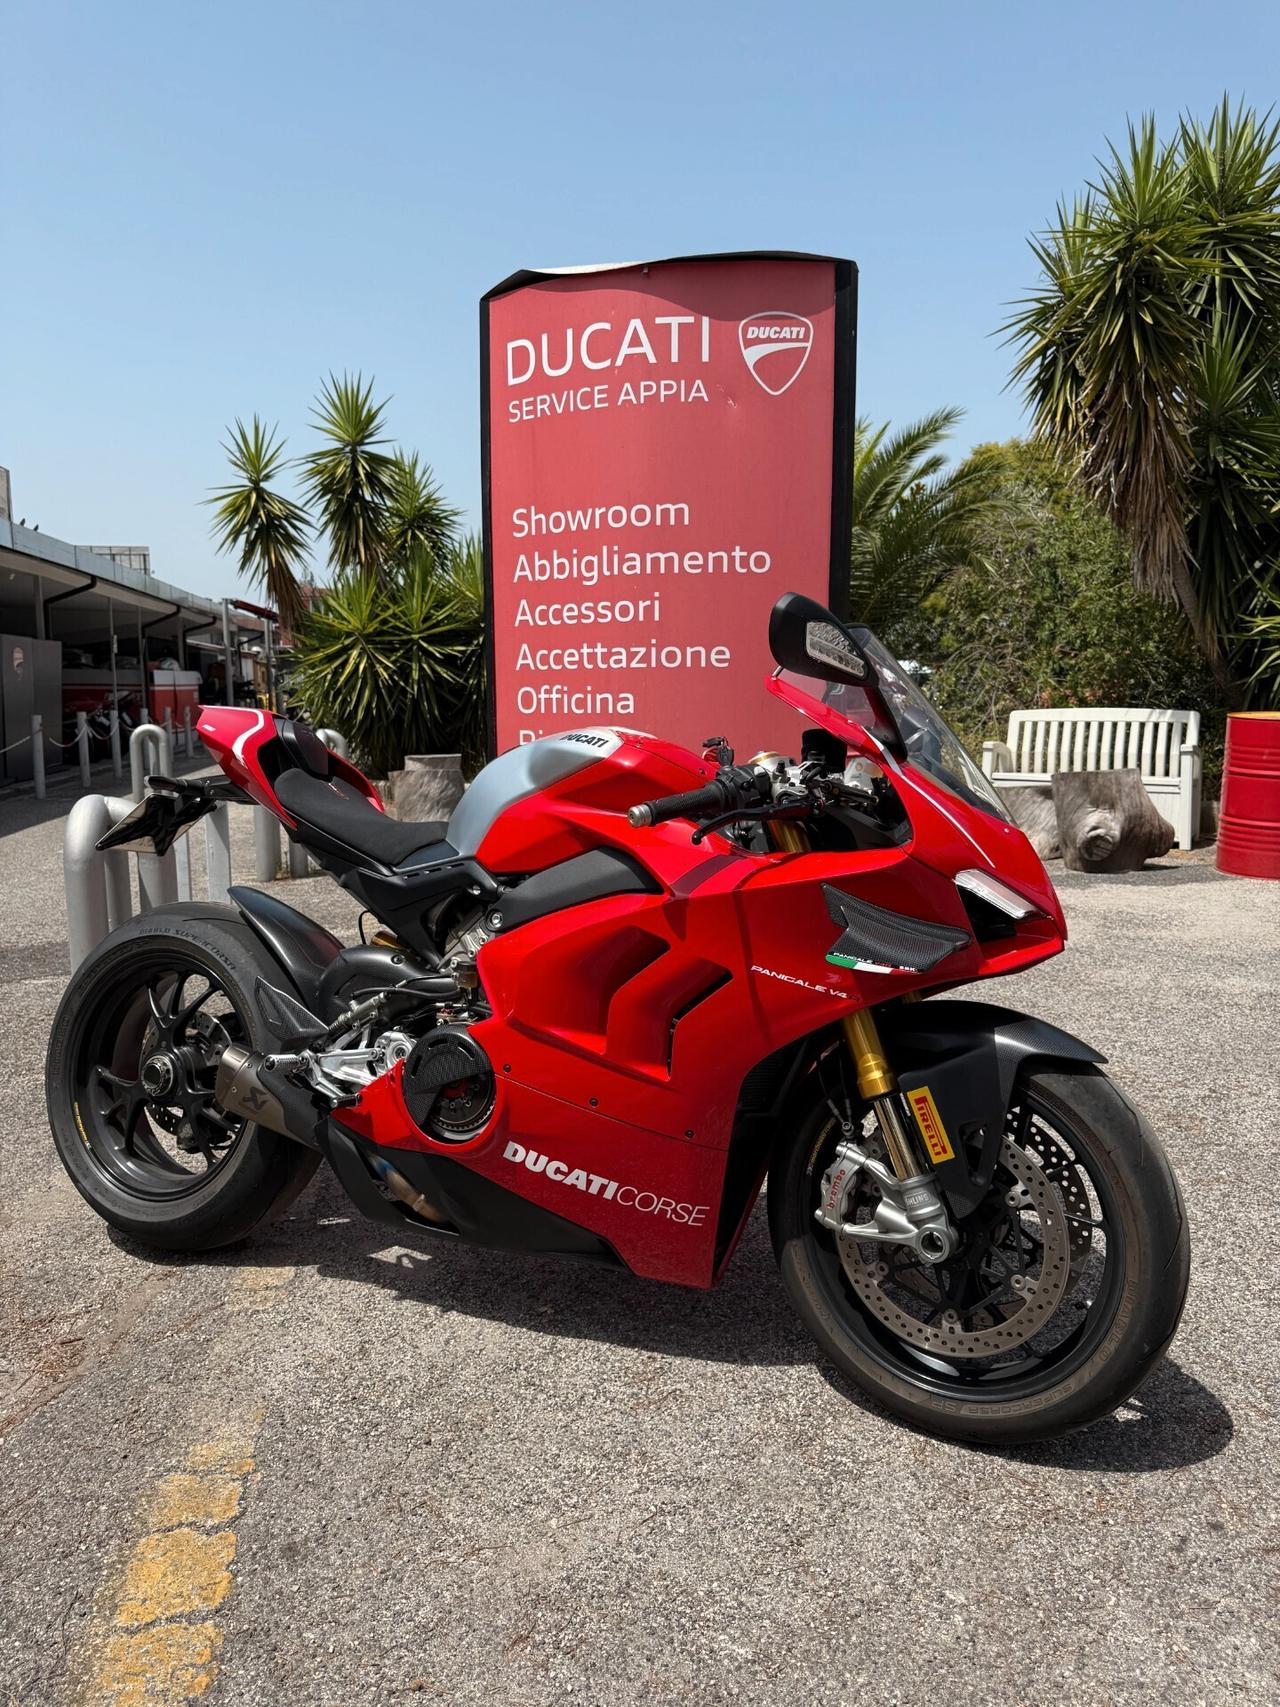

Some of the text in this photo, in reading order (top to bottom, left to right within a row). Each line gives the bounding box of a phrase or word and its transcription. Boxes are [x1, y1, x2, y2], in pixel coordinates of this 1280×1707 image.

[746, 326, 806, 339] DUCATI
[506, 316, 710, 386] DUCATI
[508, 379, 709, 423] SERVICE APPIA
[512, 502, 690, 538] Showroom
[513, 545, 772, 586] Abbigliamento
[514, 591, 660, 627] Accessori
[515, 638, 731, 671] Accettazione
[516, 685, 635, 714] Officina
[914, 1095, 948, 1157] PIRELLI
